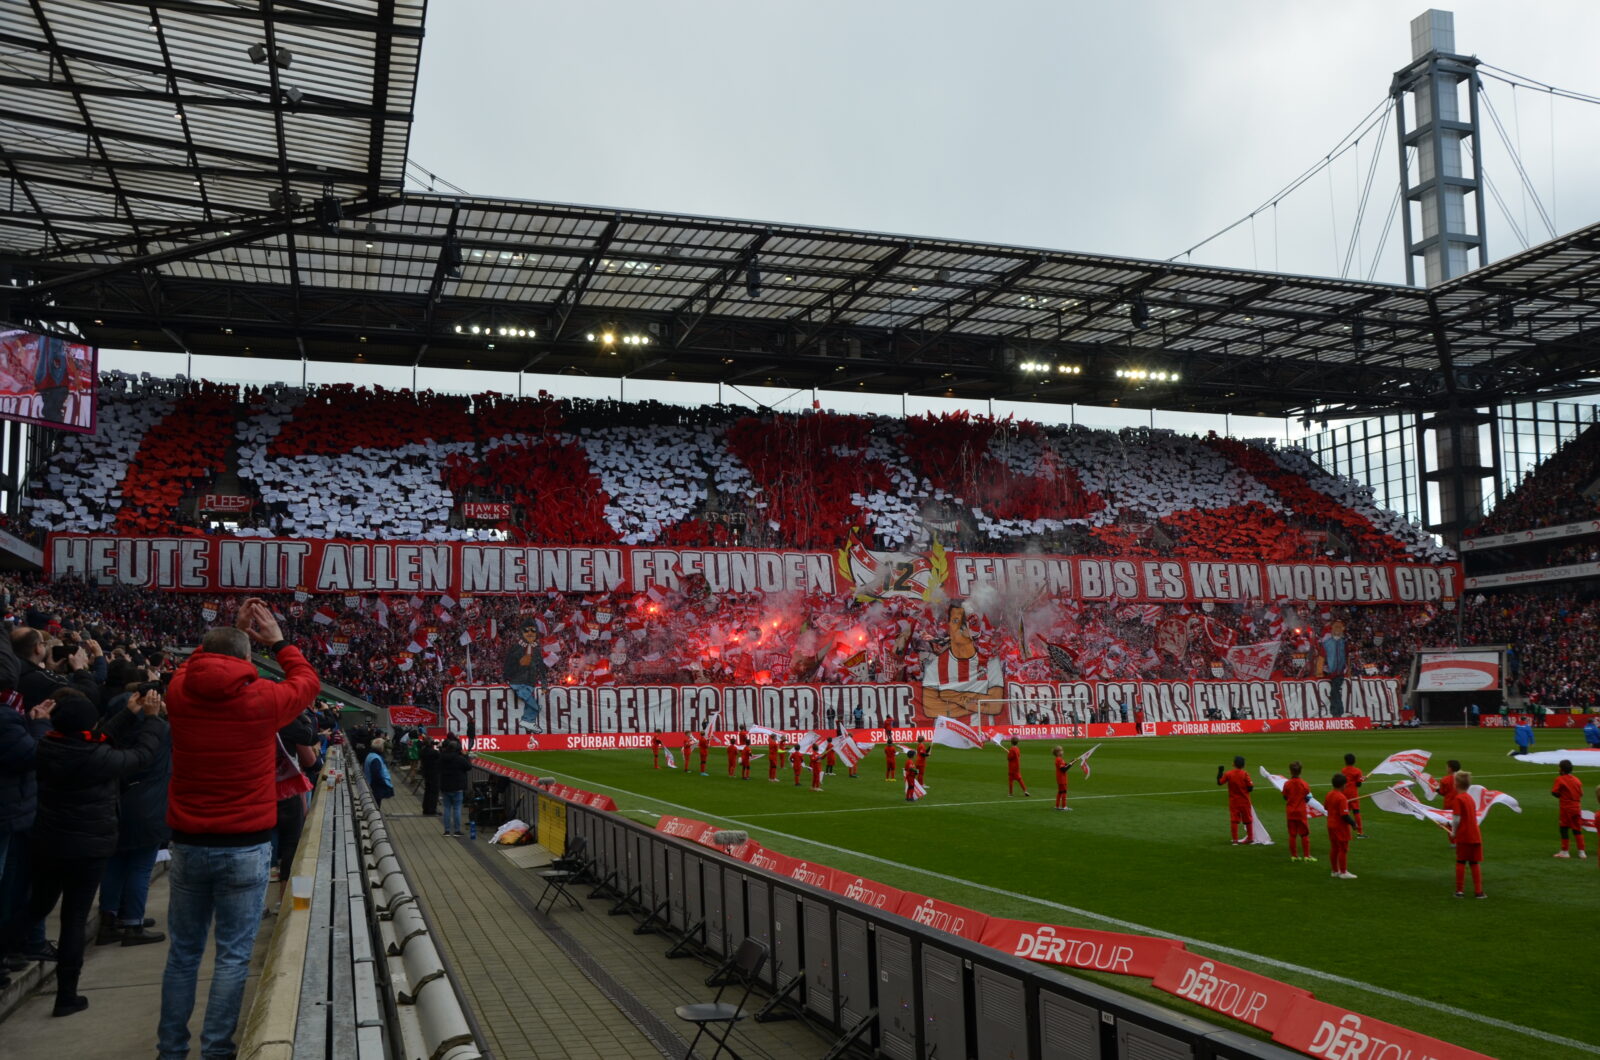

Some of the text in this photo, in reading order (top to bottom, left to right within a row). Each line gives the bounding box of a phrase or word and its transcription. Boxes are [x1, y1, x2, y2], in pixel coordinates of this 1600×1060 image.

[205, 494, 246, 508] PLEES
[464, 503, 510, 516] HAWKS
[53, 537, 837, 595] HEUTE MIT ALLEN MEINEN FREUNDEN
[883, 561, 914, 592] 12
[955, 557, 1457, 604] FEIERN BIS ES KEIN MORGEN GIBT
[535, 686, 594, 734] ICH
[597, 685, 678, 733] BEIM
[681, 685, 722, 732] FC
[723, 685, 760, 732] IN
[760, 684, 821, 731] DER
[821, 684, 916, 729] KURVE
[1008, 682, 1058, 724] DER
[1096, 682, 1140, 723] IST
[1141, 682, 1193, 722] DAS
[1193, 680, 1281, 721] EINZIGE
[1282, 679, 1332, 719] WAS
[1172, 720, 1244, 734] SPÜRBAR ANDERS.
[1290, 718, 1357, 731] SPÜRBAR ANDERS.
[567, 735, 661, 749] SPÜRBAR ANDER.
[911, 905, 965, 935] DERTOUR
[1015, 930, 1134, 972] DERTOUR
[1176, 966, 1267, 1024] DERTOUR
